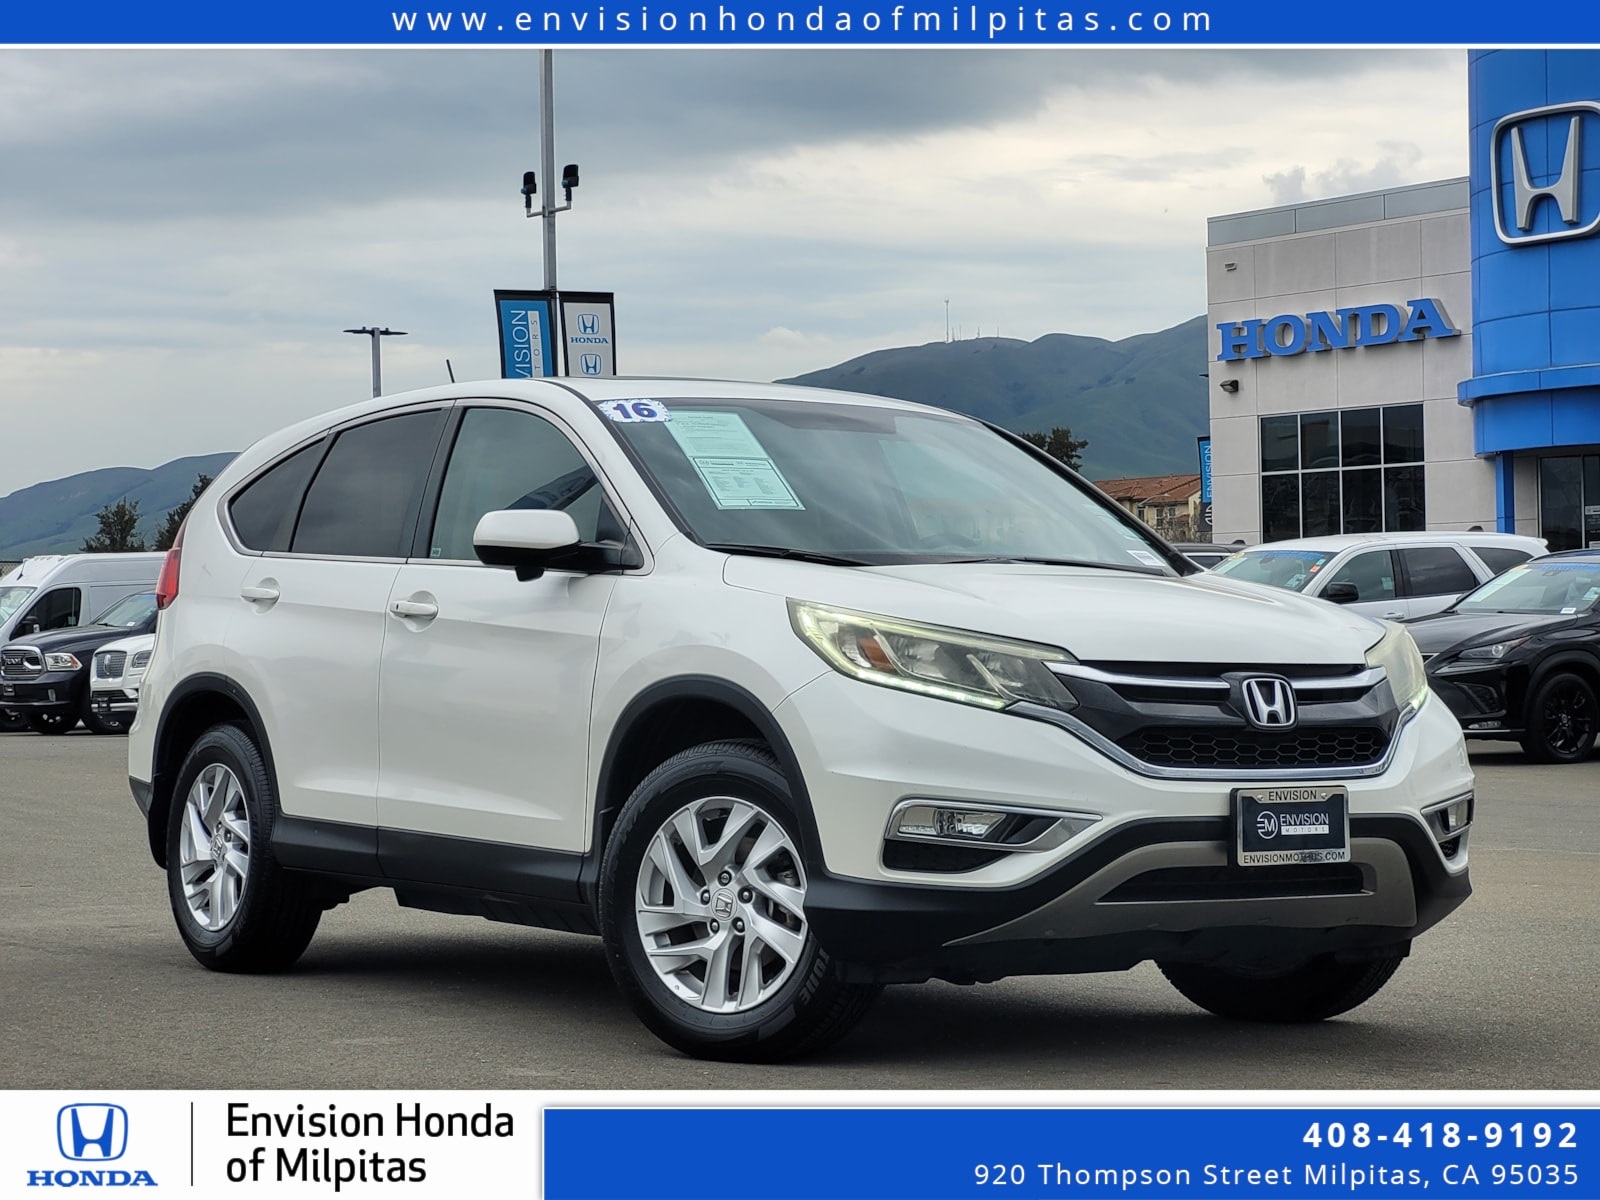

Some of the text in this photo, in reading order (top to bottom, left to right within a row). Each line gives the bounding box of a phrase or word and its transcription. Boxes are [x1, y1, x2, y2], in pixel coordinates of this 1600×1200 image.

[1216, 297, 1460, 361] HONDA
[612, 402, 658, 419] 16
[1268, 790, 1317, 801] ENVISION
[1280, 813, 1329, 826] ENVISION
[1243, 851, 1346, 864] ENVISIONMOS.COM
